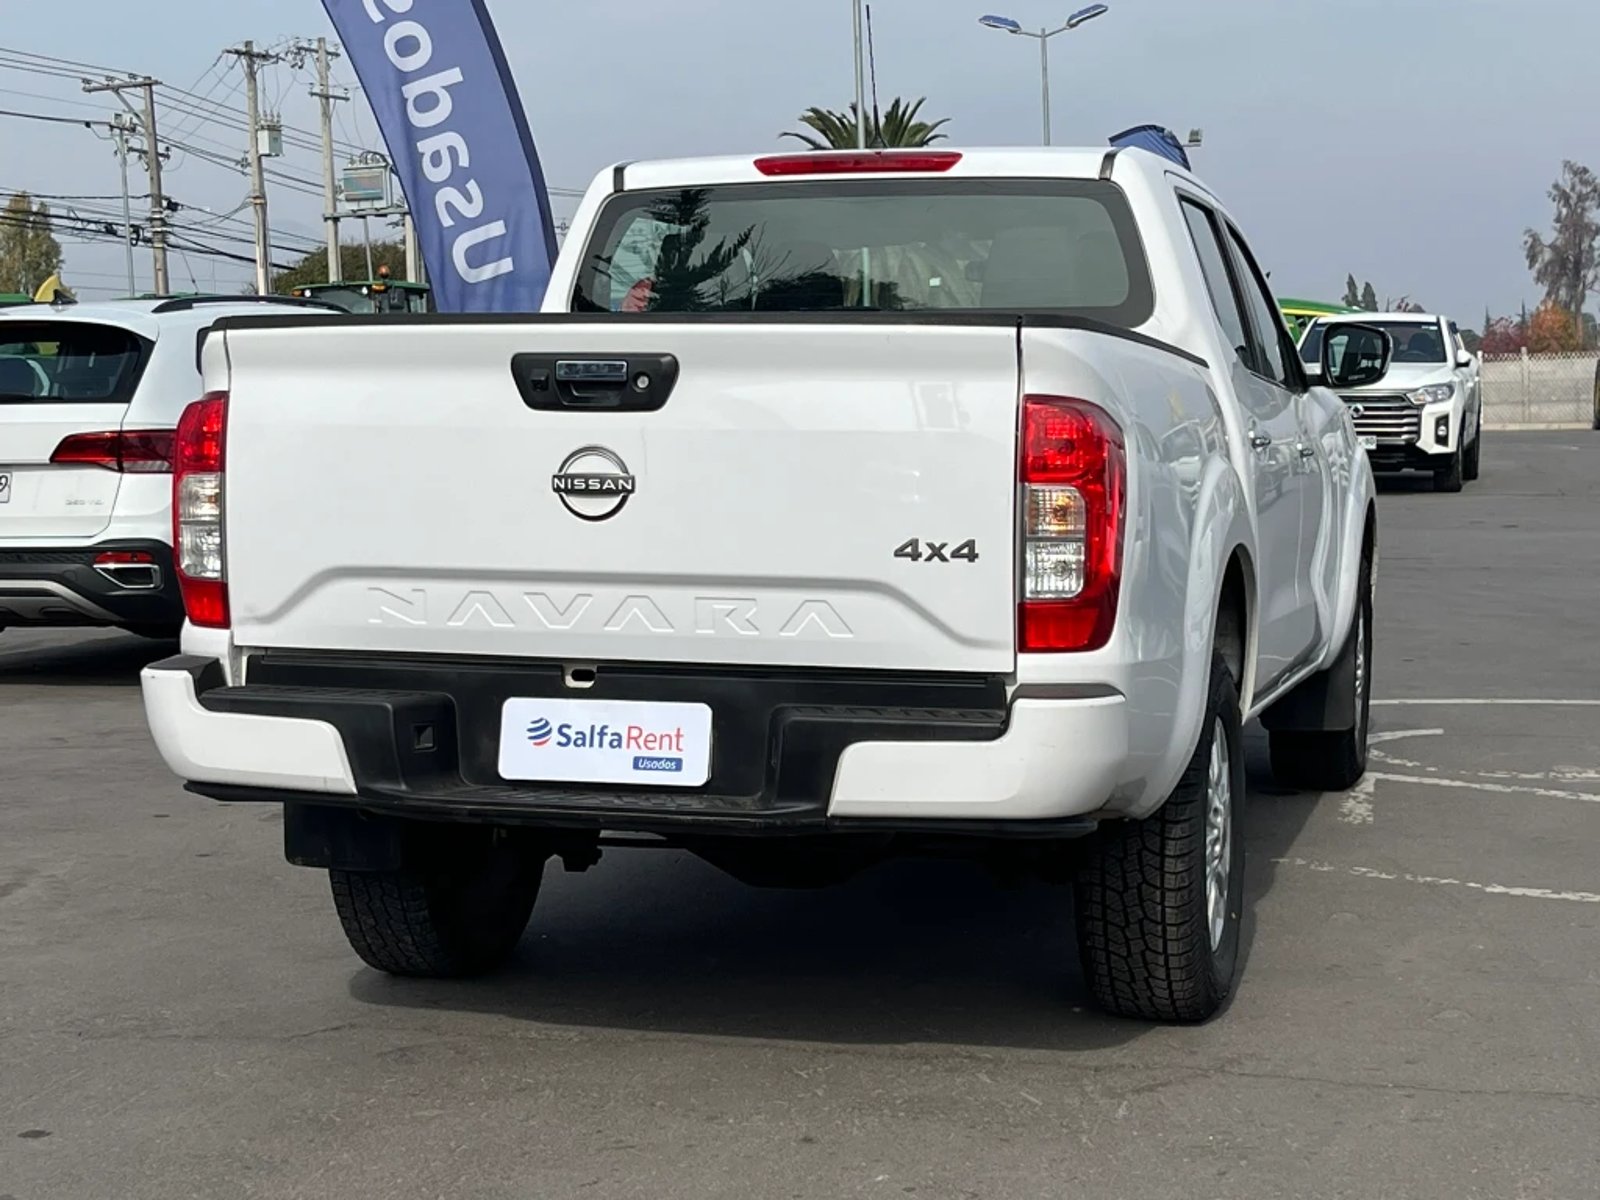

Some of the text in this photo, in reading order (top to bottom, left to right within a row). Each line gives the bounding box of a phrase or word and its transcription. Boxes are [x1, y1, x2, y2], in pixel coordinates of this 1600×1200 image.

[553, 477, 633, 490] NISSAN
[893, 537, 980, 563] 4x4
[367, 586, 854, 637] NAVARA
[556, 723, 685, 752] SalfaRent
[638, 757, 676, 770] Usados
